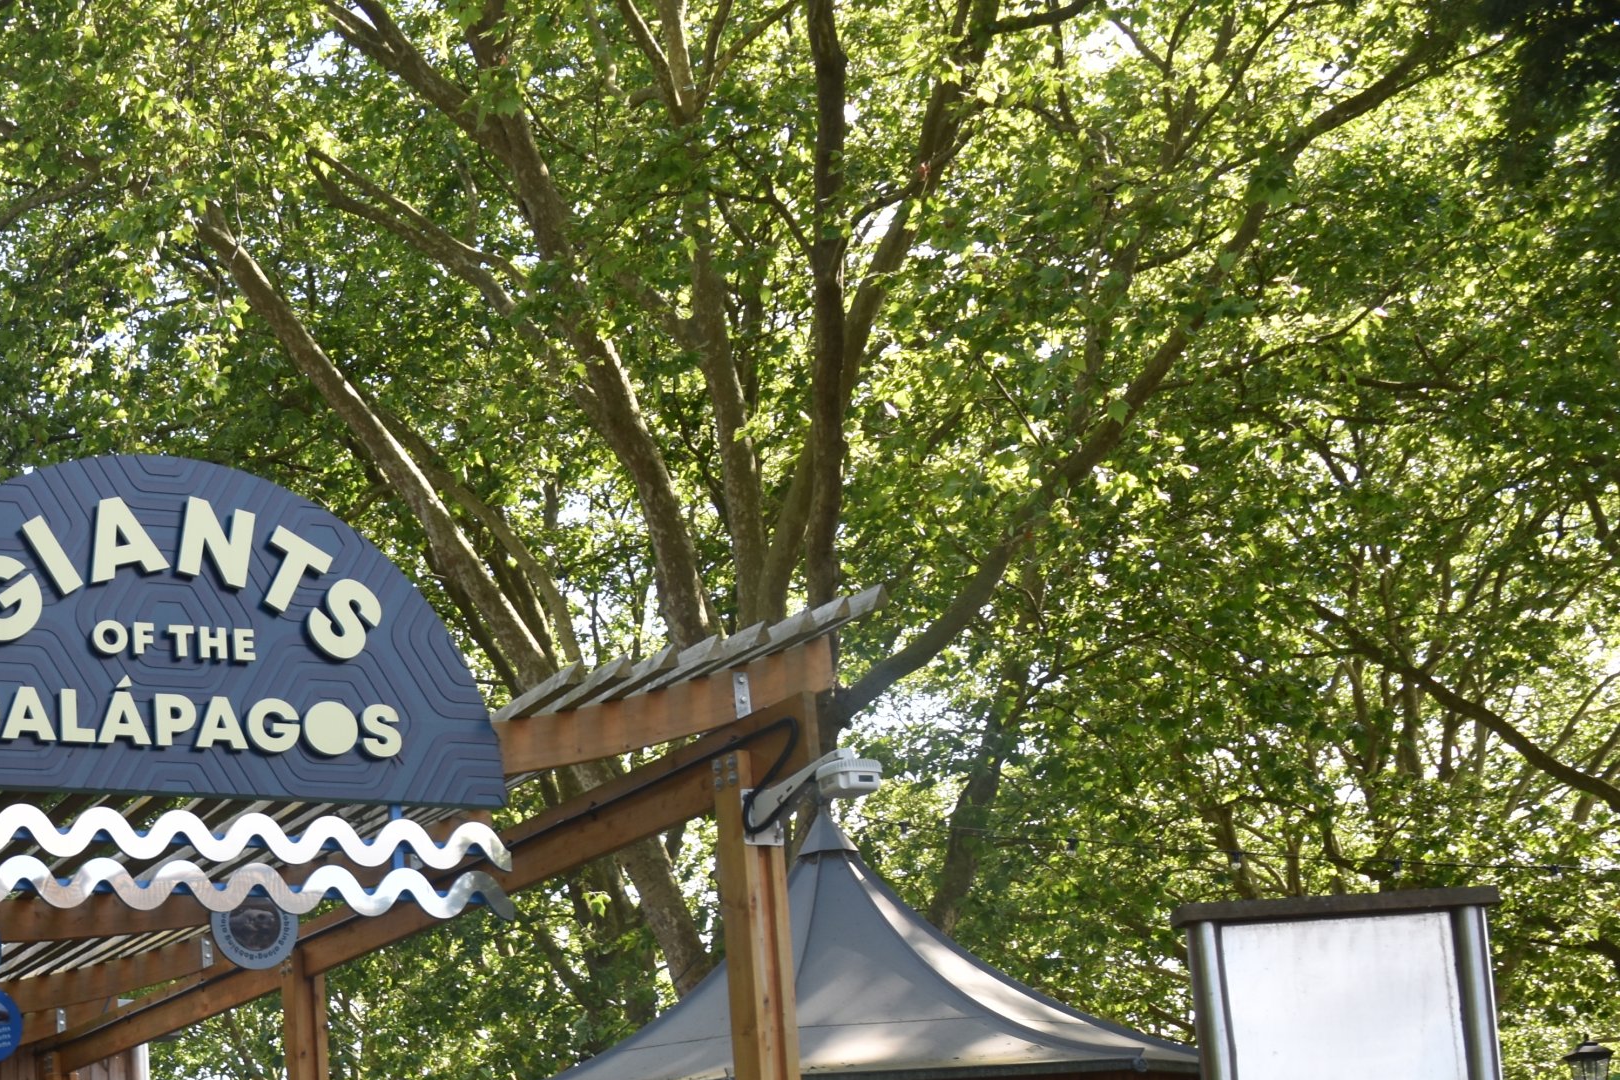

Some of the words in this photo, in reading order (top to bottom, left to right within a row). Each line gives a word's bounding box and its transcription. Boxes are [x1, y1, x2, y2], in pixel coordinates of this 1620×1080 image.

[91, 619, 154, 656] OF
[167, 623, 256, 662] THE
[220, 912, 229, 933] alon
[258, 945, 280, 960] along
